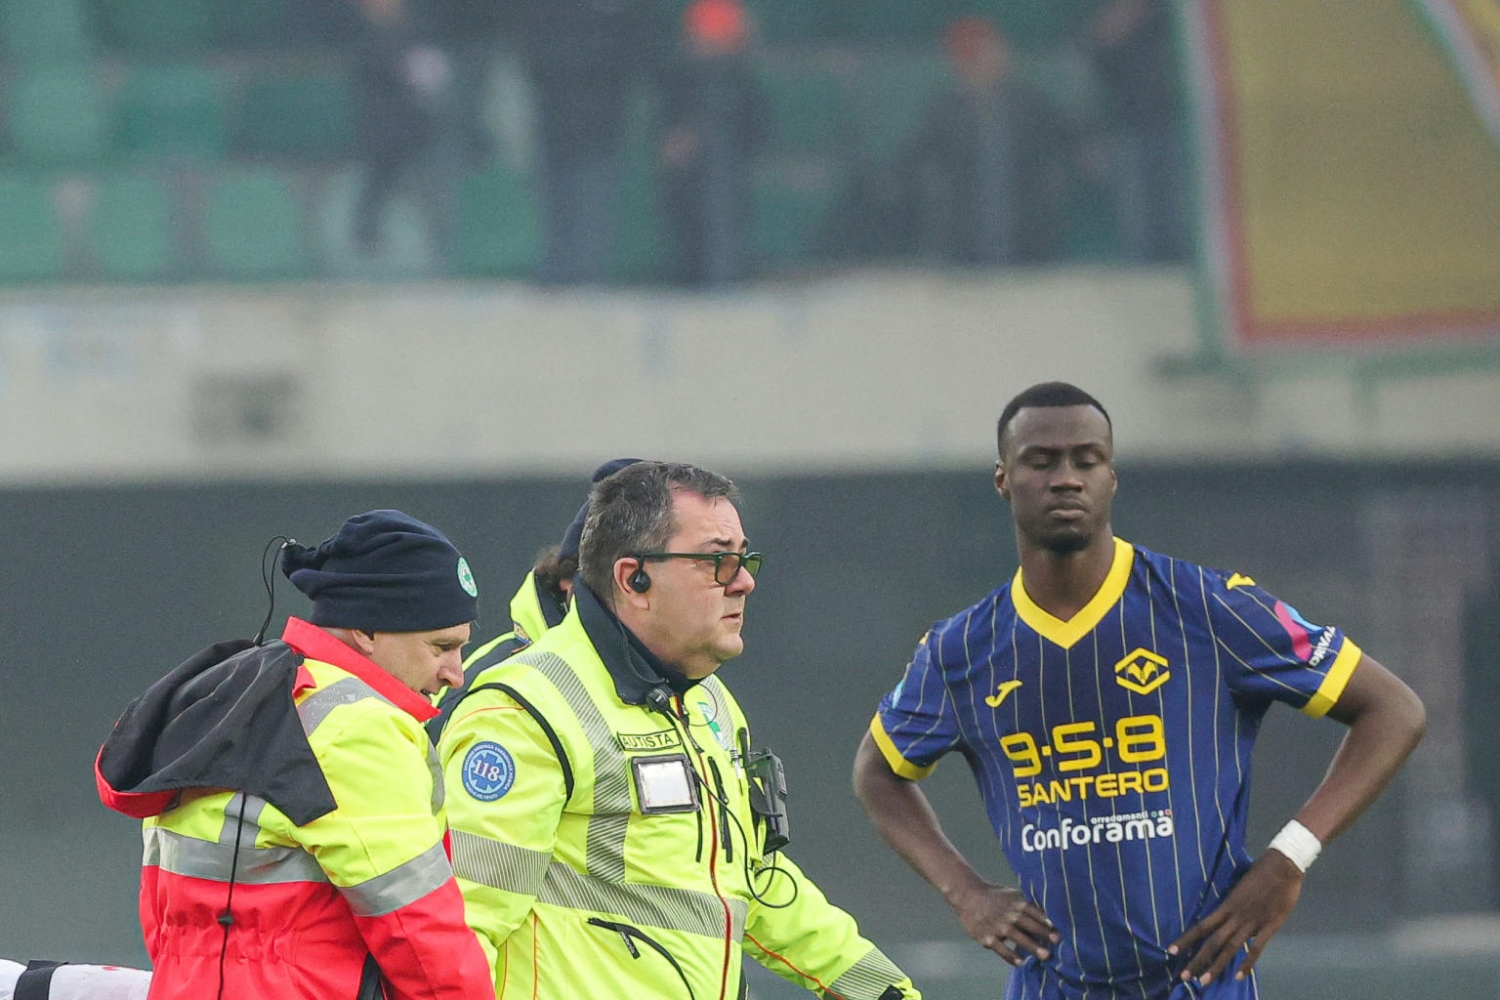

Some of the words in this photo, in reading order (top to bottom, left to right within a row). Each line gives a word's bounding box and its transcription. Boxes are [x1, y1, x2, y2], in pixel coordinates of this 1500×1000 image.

[622, 733, 674, 748] AUTISTA
[473, 759, 500, 782] 118
[1017, 768, 1169, 807] SANTERO
[1021, 817, 1174, 852] Conforama
